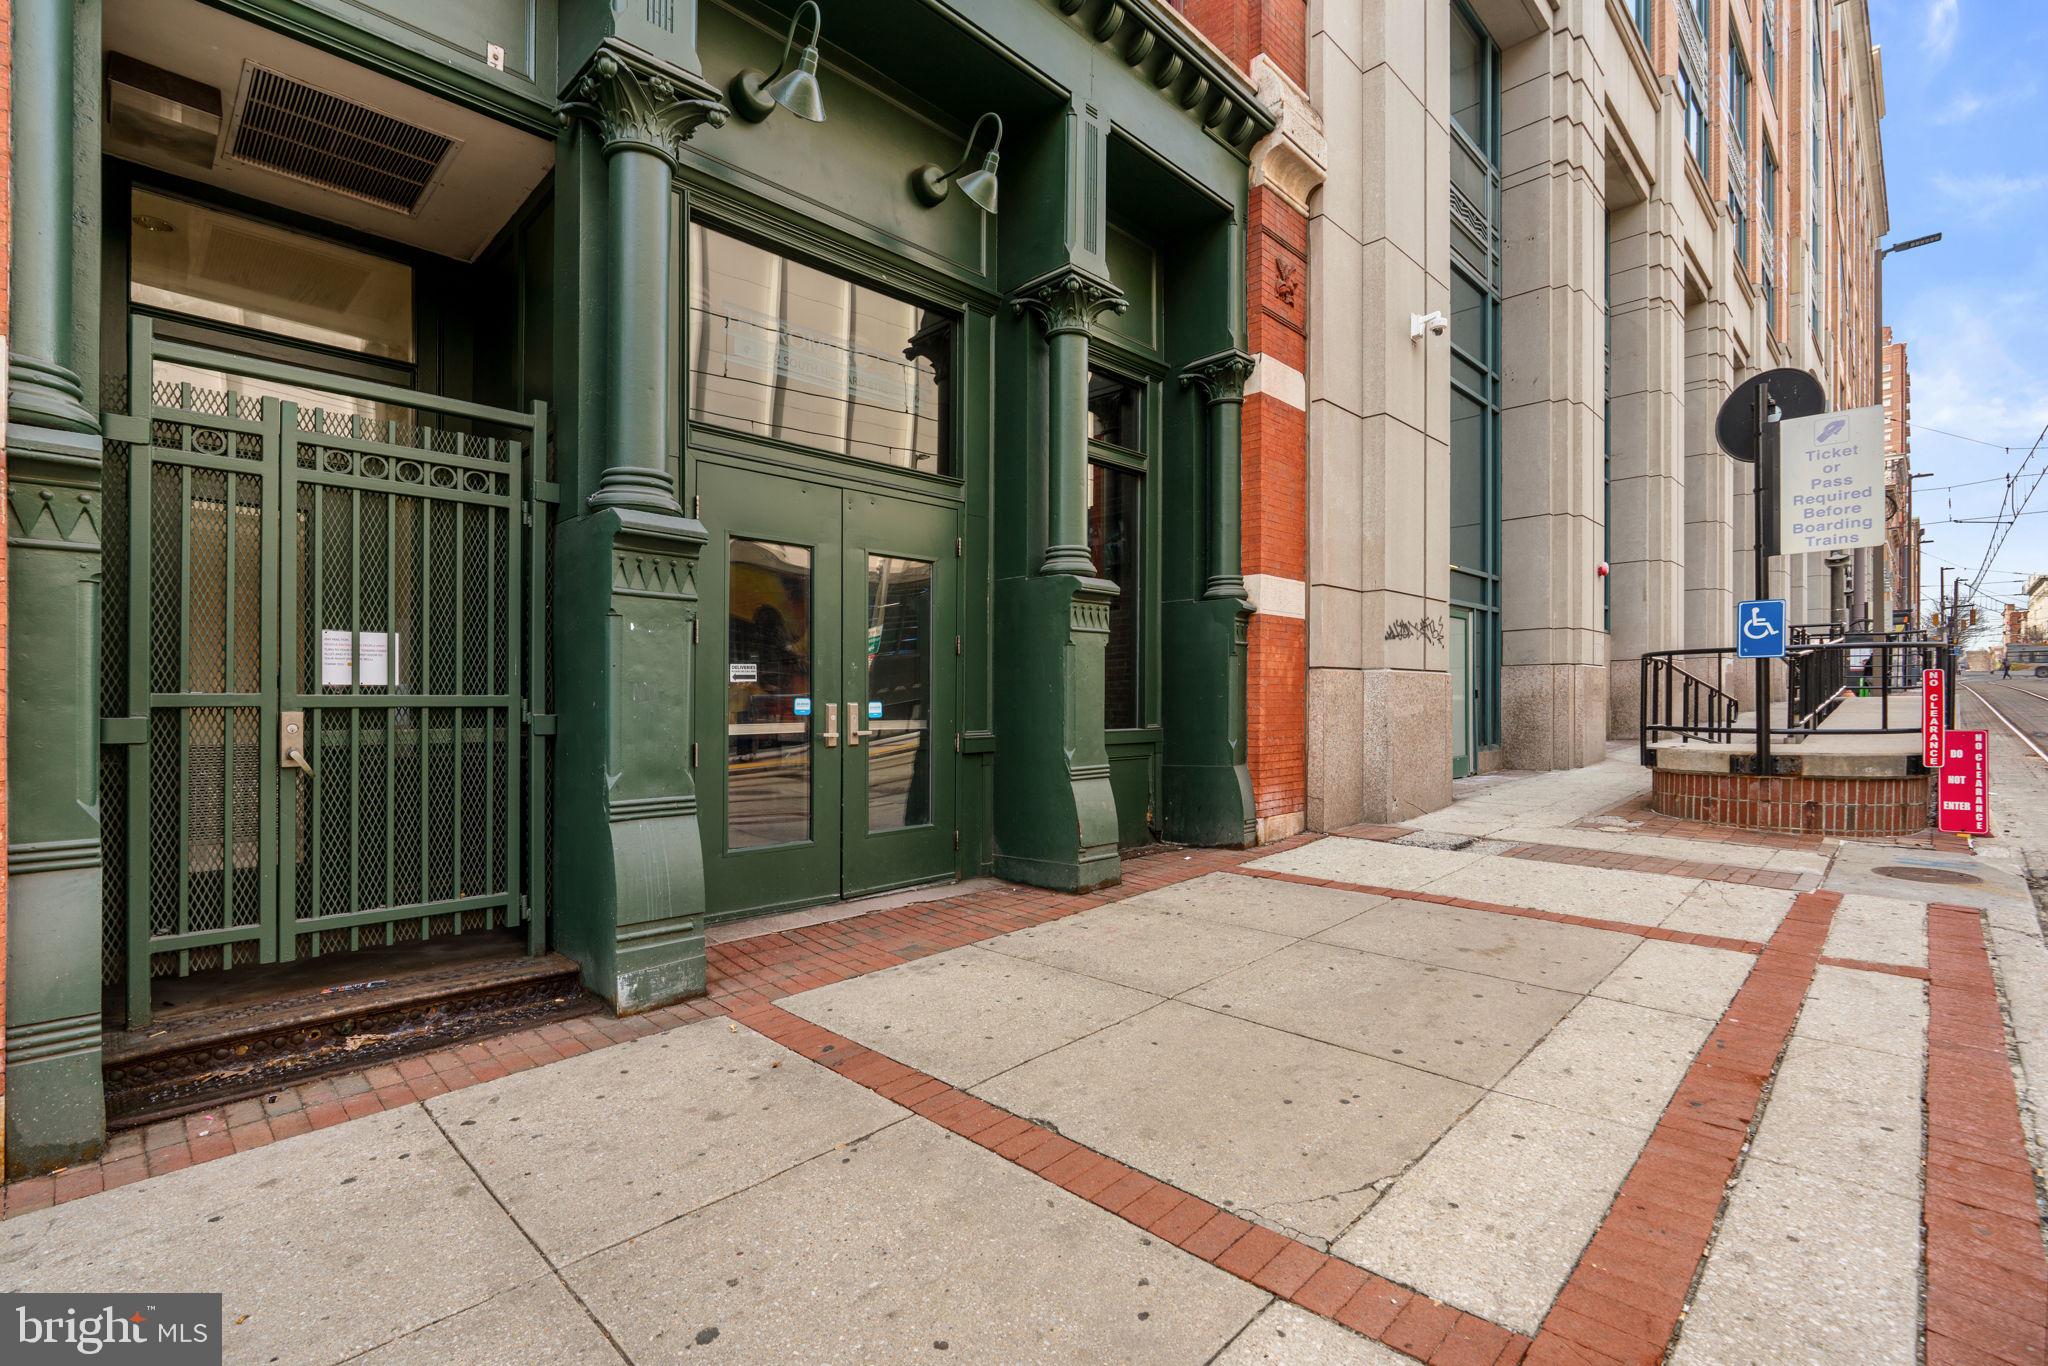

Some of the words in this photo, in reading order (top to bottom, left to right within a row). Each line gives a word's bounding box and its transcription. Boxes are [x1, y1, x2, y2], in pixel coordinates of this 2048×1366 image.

[1806, 445, 1859, 461] Ticket
[1823, 464, 1840, 473] or
[1811, 476, 1853, 489] Pass
[1793, 486, 1872, 506] Required
[1803, 504, 1862, 519] Before
[1792, 518, 1873, 534] Boarding
[1805, 534, 1859, 546] Trains
[1929, 672, 1938, 687] NO
[1929, 693, 1938, 765] CLEARANCE
[1975, 733, 1982, 750] NO
[1950, 750, 1963, 758] DO
[1948, 775, 1966, 784] NOT
[1975, 753, 1983, 830] CLEARANCE
[1943, 801, 1971, 811] ENTER
